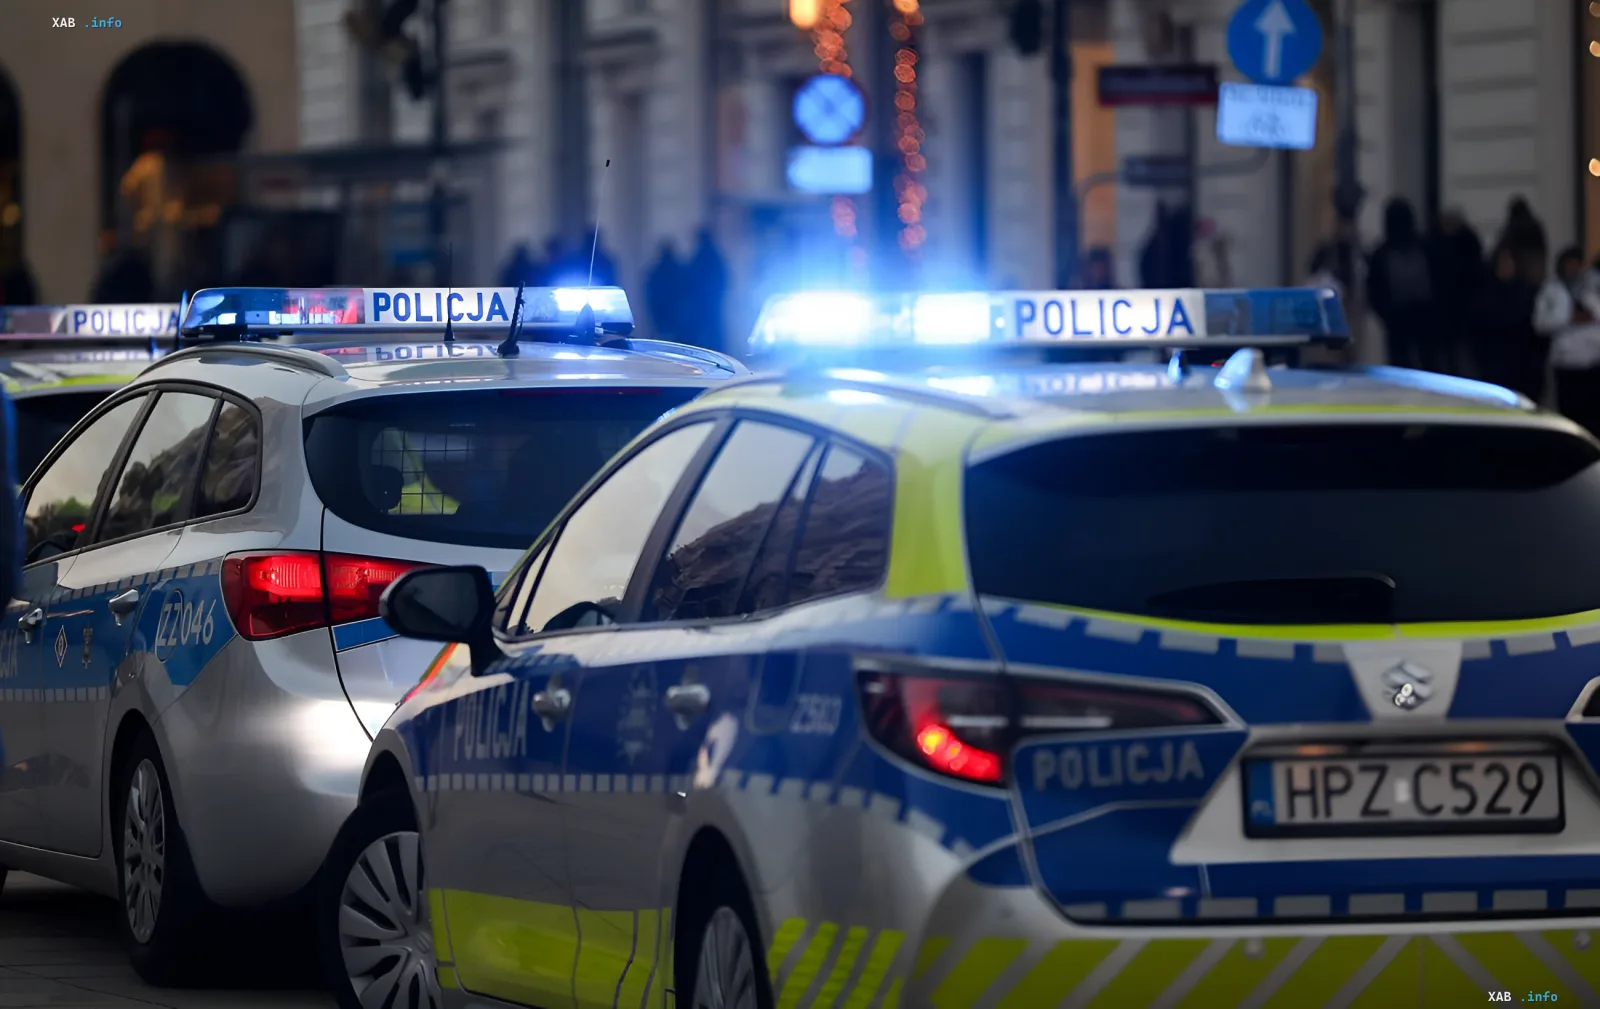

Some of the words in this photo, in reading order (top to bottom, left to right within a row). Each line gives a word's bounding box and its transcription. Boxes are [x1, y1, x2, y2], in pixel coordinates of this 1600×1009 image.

[373, 291, 510, 322] POLICJA
[1014, 297, 1195, 336] POLICJA
[1032, 740, 1205, 791] POLICJA
[1284, 762, 1392, 820] HPZ
[1411, 761, 1544, 817] C529
